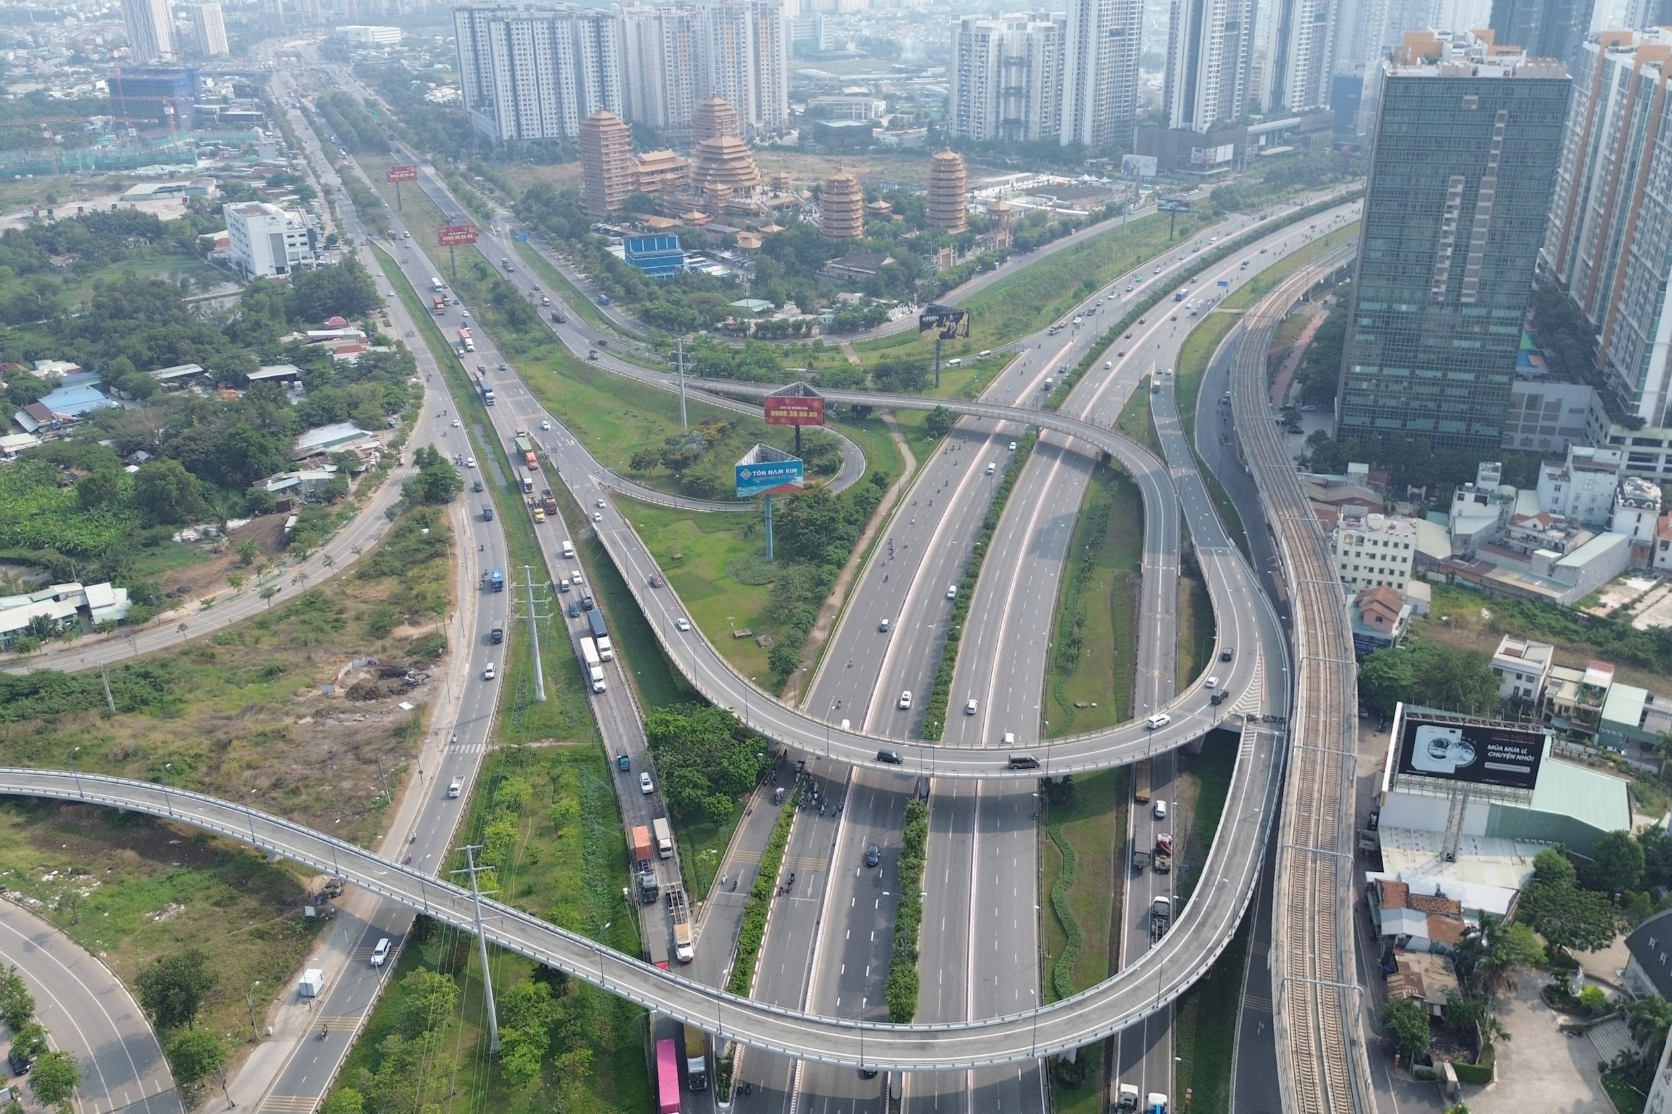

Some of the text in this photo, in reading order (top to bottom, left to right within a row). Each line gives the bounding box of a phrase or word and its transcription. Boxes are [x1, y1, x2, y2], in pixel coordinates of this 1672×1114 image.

[752, 469, 767, 477] TÔN
[768, 468, 784, 476] NAM
[1488, 751, 1517, 760] CHUYỆN
